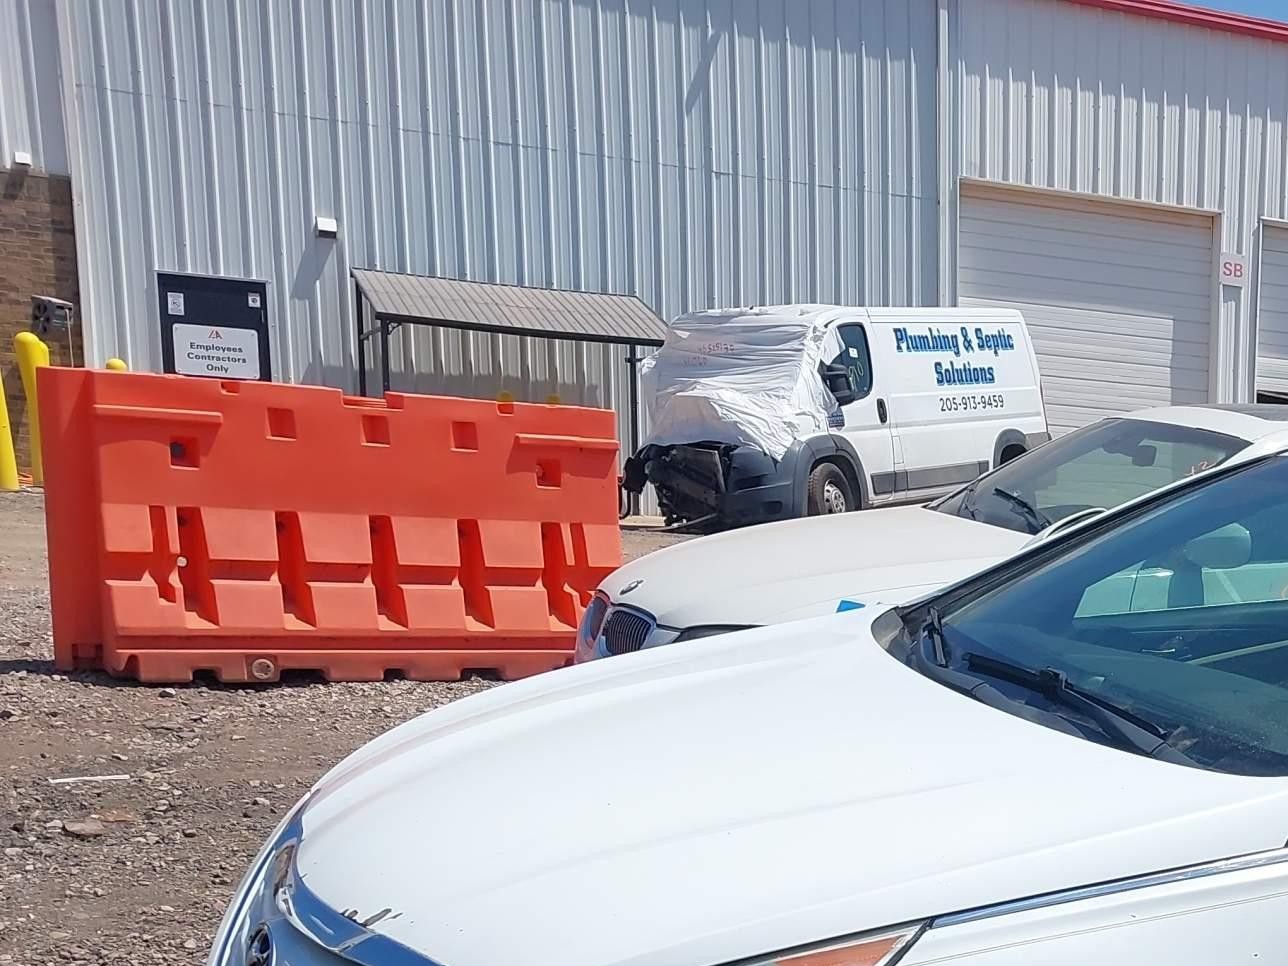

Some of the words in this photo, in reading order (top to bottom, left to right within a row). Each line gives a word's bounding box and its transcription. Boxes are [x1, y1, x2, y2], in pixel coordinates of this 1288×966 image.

[1223, 261, 1243, 278] SB
[189, 342, 243, 353] Employees
[893, 326, 961, 357] Plumbing
[960, 326, 975, 353] &
[974, 327, 1014, 357] Septic
[187, 352, 247, 364] Contractors
[206, 363, 229, 374] Only
[934, 361, 995, 386] Solutions
[939, 394, 1004, 412] 205-913-9459
